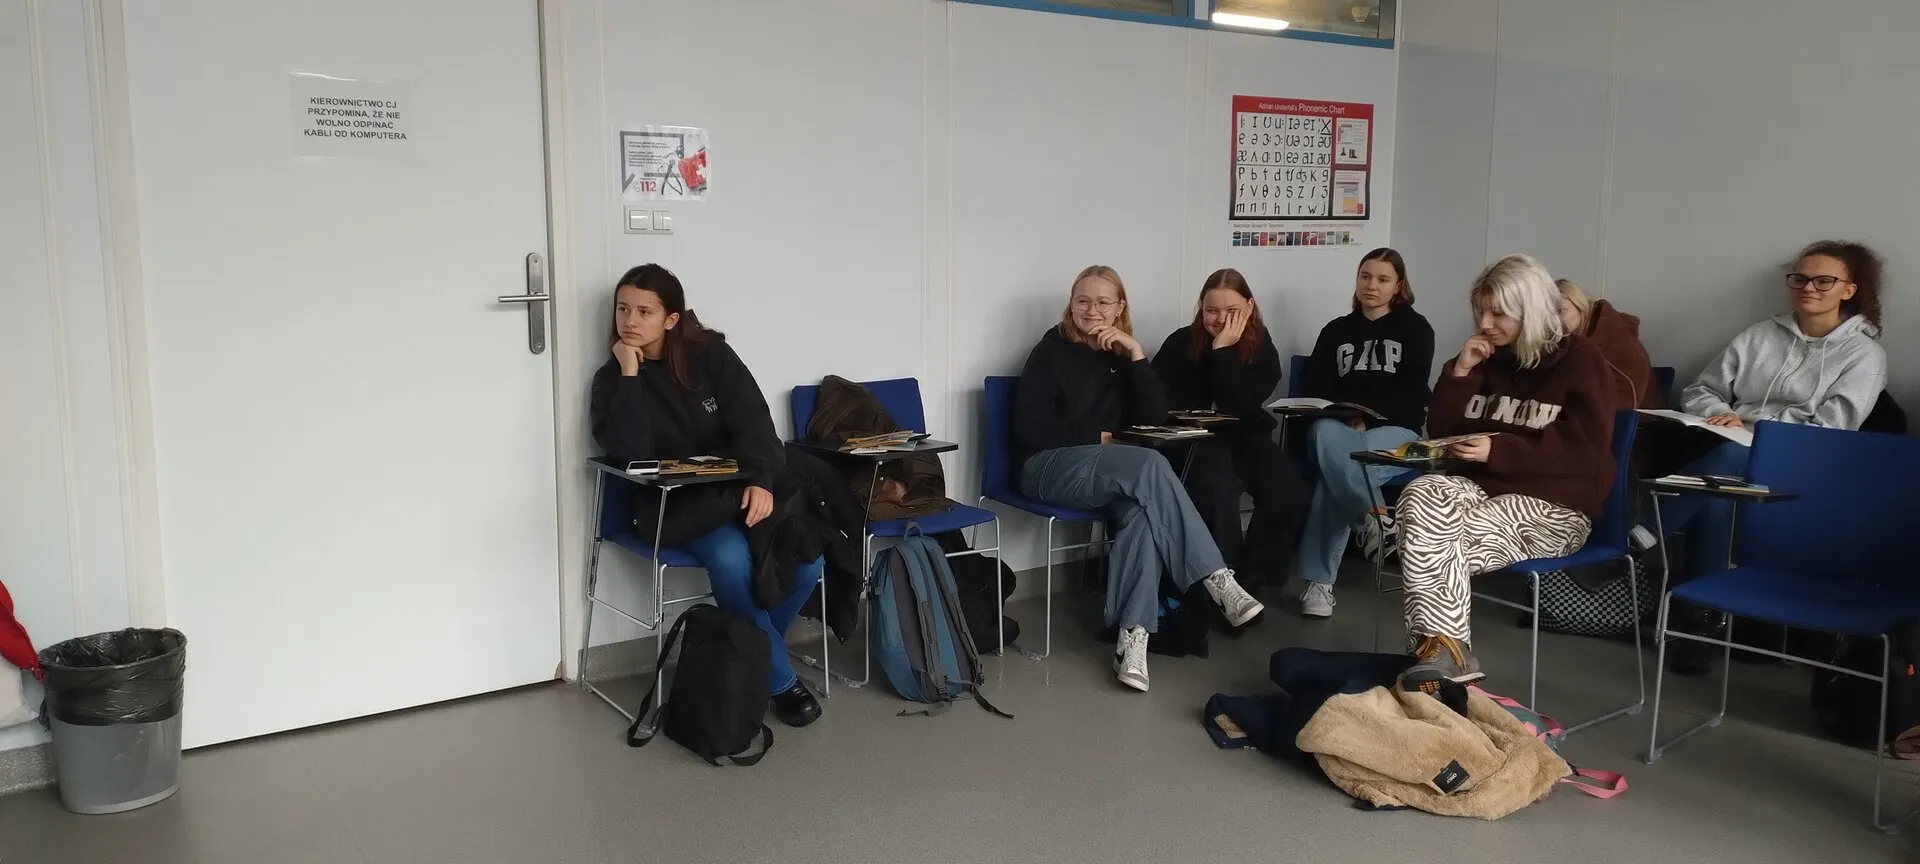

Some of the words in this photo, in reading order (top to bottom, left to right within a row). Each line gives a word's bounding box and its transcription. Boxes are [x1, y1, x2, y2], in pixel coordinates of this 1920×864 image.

[310, 97, 383, 108] KIEROWNICTWO
[308, 108, 370, 118] PRZYPOMINA,
[1298, 103, 1328, 113] Phonemic
[1329, 105, 1345, 114] Chart
[316, 119, 351, 127] WOLNO
[353, 121, 394, 129] ODPINAĆ
[350, 131, 406, 139] KOMPUTERA
[640, 181, 656, 192] 112
[1336, 339, 1402, 377] GAP
